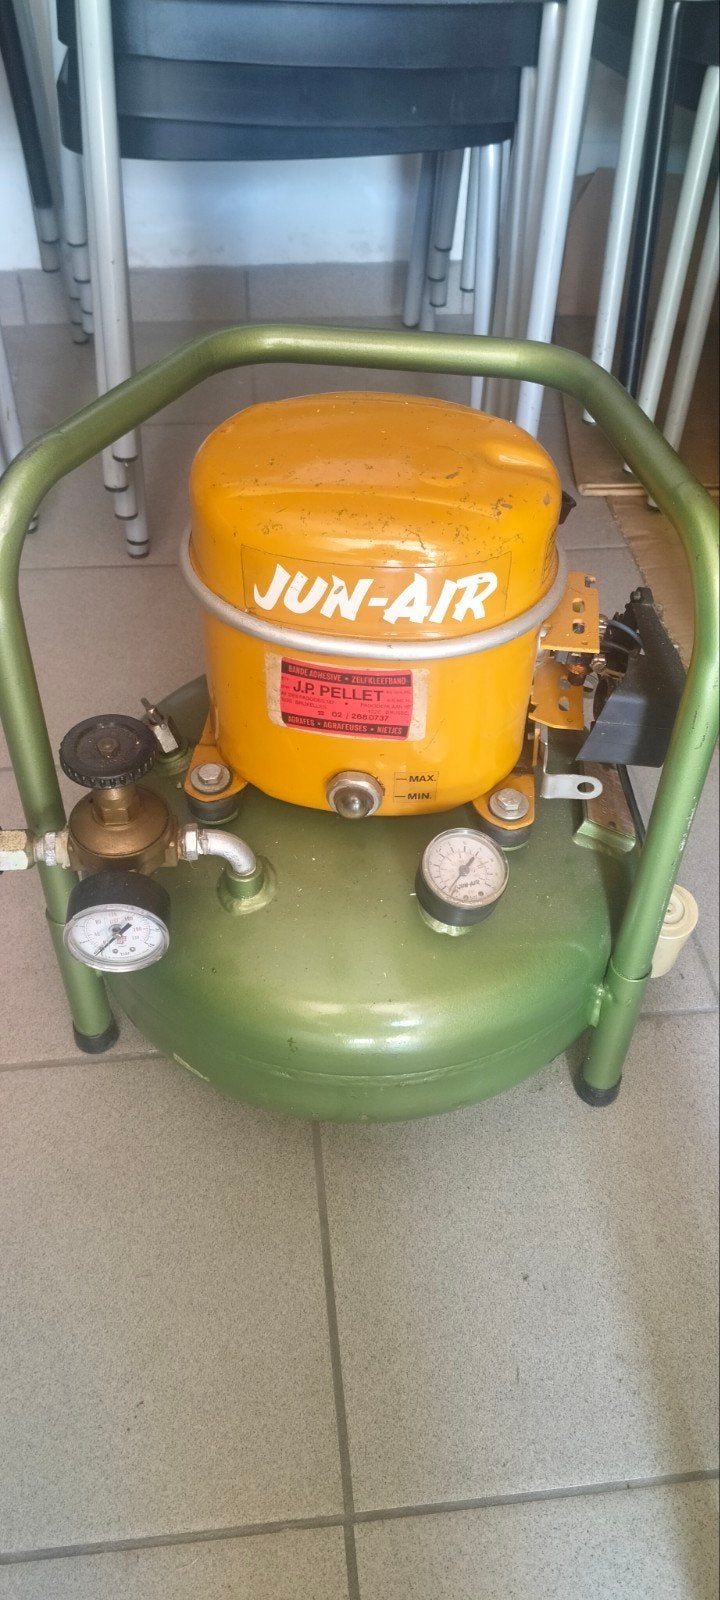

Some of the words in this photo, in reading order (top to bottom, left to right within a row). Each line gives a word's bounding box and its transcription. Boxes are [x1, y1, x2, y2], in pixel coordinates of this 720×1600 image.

[253, 563, 498, 625] JUN-AIR
[288, 664, 309, 677] BANDE
[309, 669, 342, 682] ADHESIVE
[351, 675, 407, 685] ZELFKLEEFBAND
[293, 680, 315, 695] J.P.
[320, 684, 384, 702] PELLET
[287, 715, 316, 727] AGRAFES
[323, 721, 368, 733] AGRAFEUSES
[376, 726, 403, 735] NIETJES
[408, 774, 437, 783] MAX.
[407, 792, 433, 800] MIN.
